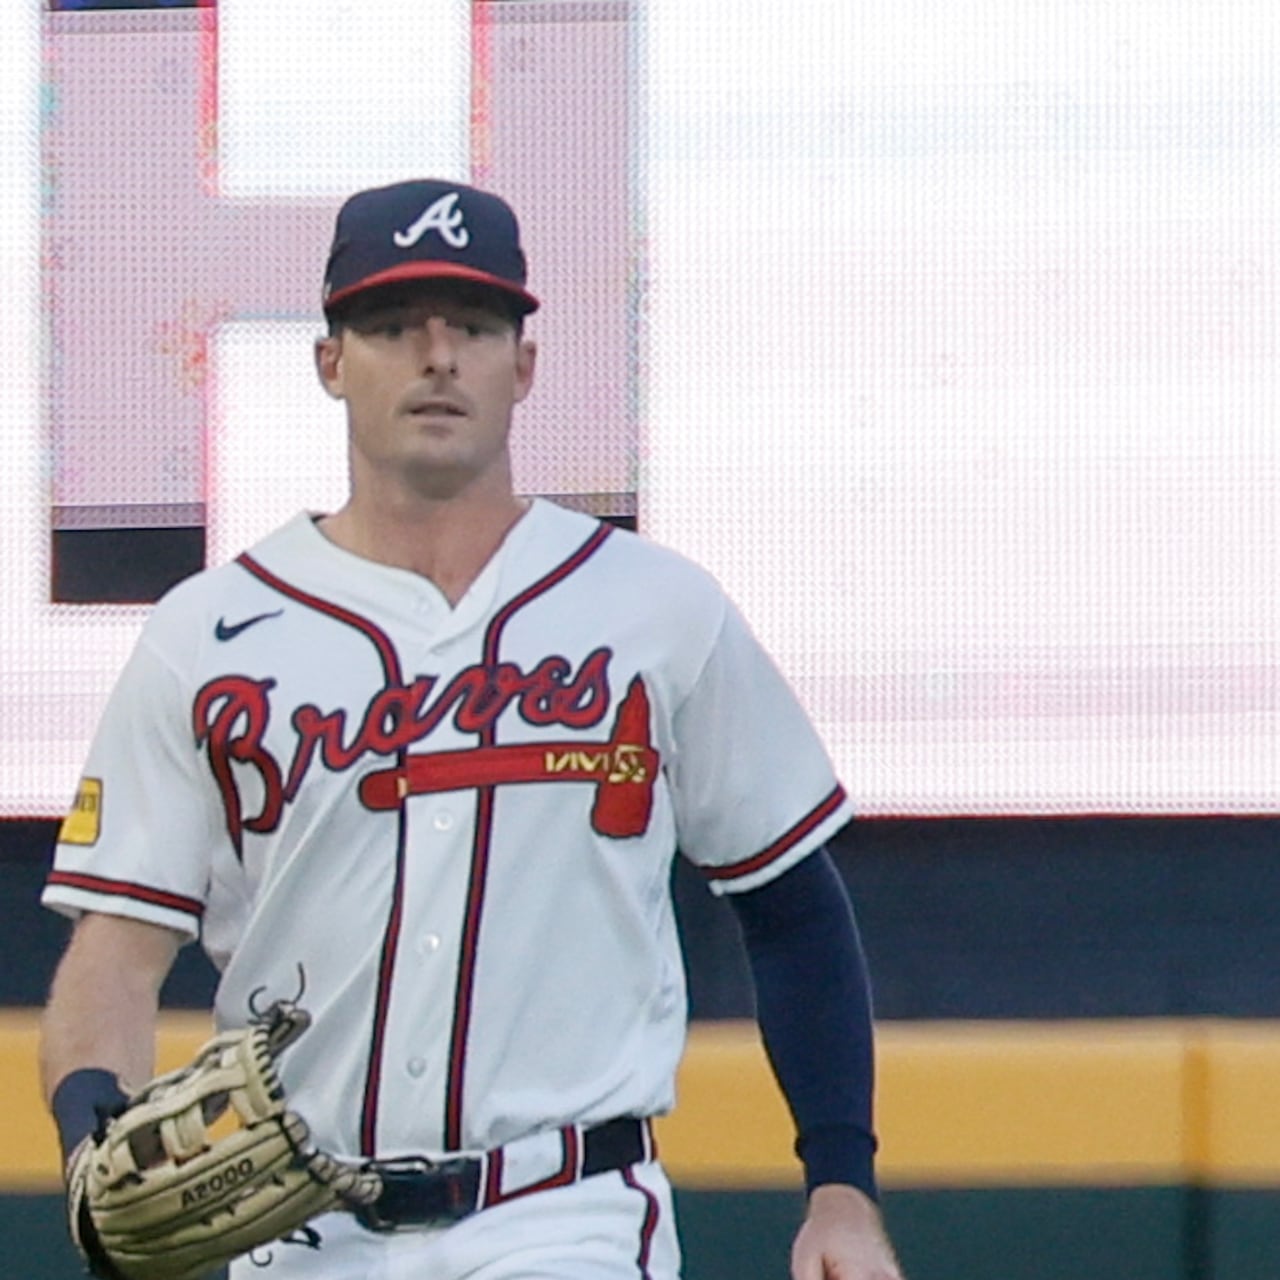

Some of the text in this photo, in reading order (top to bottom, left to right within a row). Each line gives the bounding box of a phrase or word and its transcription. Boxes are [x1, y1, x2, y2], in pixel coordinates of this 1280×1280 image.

[393, 192, 469, 248] A
[192, 645, 613, 867] Braves
[182, 1158, 253, 1209] A2000
